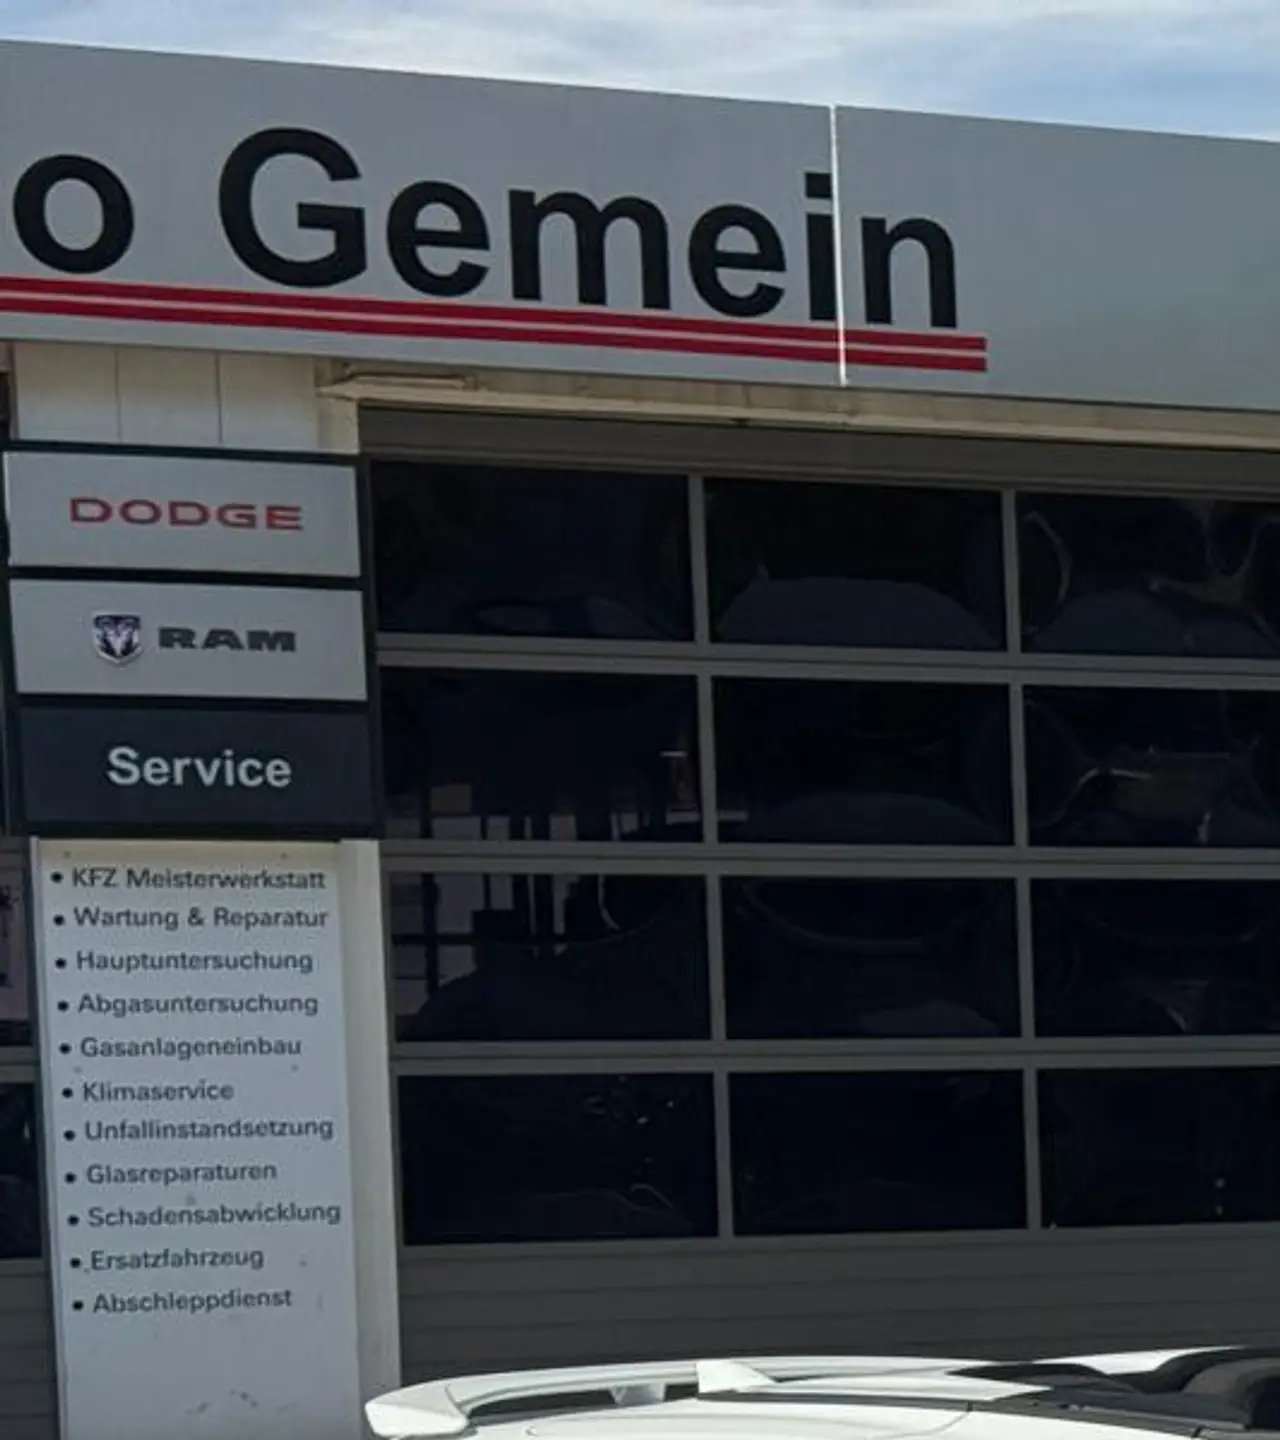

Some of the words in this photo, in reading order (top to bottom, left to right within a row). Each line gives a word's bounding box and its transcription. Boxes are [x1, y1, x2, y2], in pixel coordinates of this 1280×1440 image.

[13, 152, 135, 274] o
[217, 126, 960, 329] Gemein
[69, 497, 305, 532] DODGE
[157, 626, 297, 653] RAM
[106, 746, 293, 788] Service
[72, 868, 118, 890] KFZ
[126, 868, 326, 890] Meisterwerkstatt
[74, 907, 180, 930] Wartung
[187, 908, 205, 928] &
[213, 907, 328, 930] Reparatur
[75, 950, 314, 974] Hauptuntersuchung
[77, 994, 319, 1017] Abgasuntersuchung
[79, 1037, 302, 1061] Gasanlageneinbau
[82, 1082, 235, 1102] Klimaservice
[84, 1118, 334, 1143] Unfallinstandsetzung
[86, 1163, 278, 1187] Glasreparaturen
[88, 1204, 342, 1229] Schadensabwicklung
[90, 1249, 265, 1271] Ersatzfahrzeug
[93, 1290, 292, 1314] Abschleppdienst
